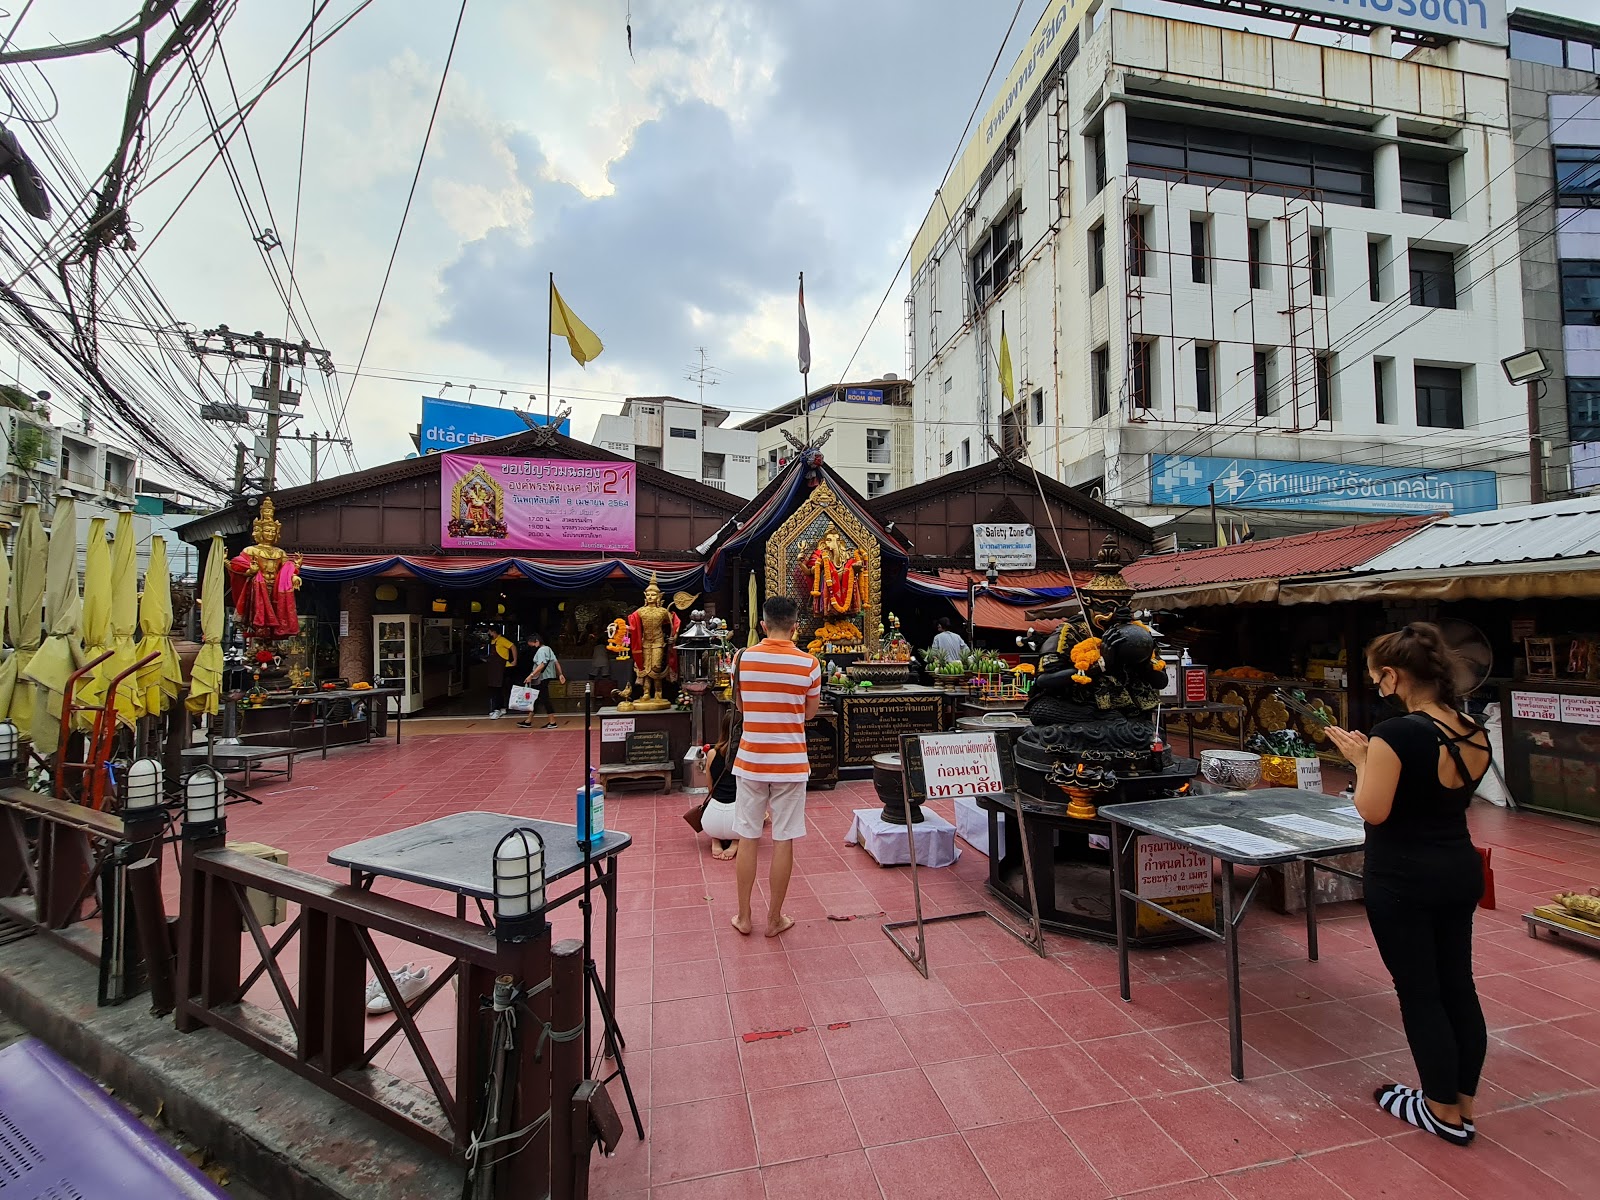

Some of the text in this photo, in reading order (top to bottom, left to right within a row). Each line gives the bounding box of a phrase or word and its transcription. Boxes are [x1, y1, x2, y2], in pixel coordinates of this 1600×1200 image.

[426, 426, 465, 444] dtac
[501, 461, 600, 478] ขอเชิญร่วมฉลอง
[586, 480, 600, 492] ปีที่
[603, 469, 630, 495] 21
[1257, 470, 1454, 500] สหแพทย์รัชดาคลินิก
[512, 494, 560, 505] วันพฤหัสบดีที่
[985, 526, 1025, 540] Safety Zone
[1518, 710, 1556, 719] เทวาลัย
[921, 736, 996, 758] ใส่หน้ากากอนามัยทุกครั้ง
[937, 760, 988, 777] ก่อนเข้า
[929, 777, 1002, 797] เทวาลัย
[1144, 851, 1206, 871] กำหนดไว้ให
[1142, 870, 1208, 884] ระยะห่าง 2 เมตร
